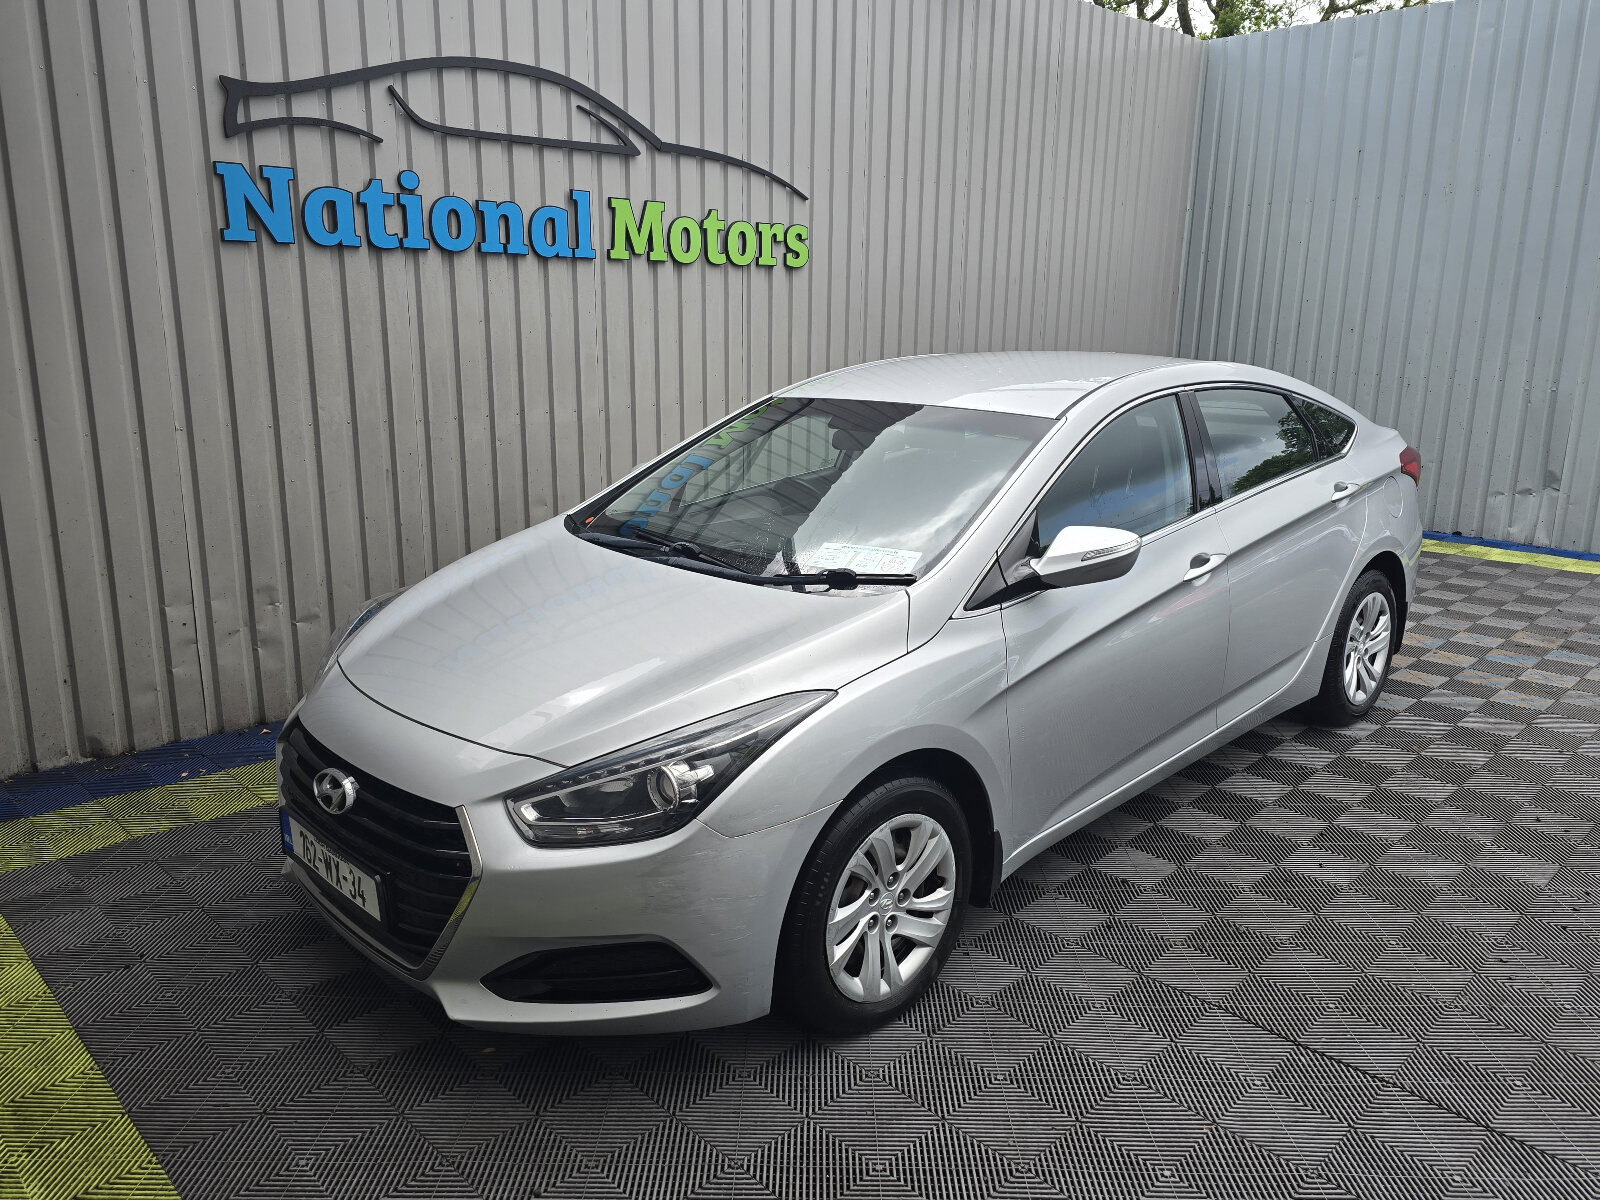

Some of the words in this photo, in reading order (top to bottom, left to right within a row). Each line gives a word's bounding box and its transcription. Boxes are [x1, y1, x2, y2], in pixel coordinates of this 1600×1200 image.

[213, 161, 596, 260] National
[608, 197, 811, 268] Motors
[300, 830, 367, 908] 162-WX-34
